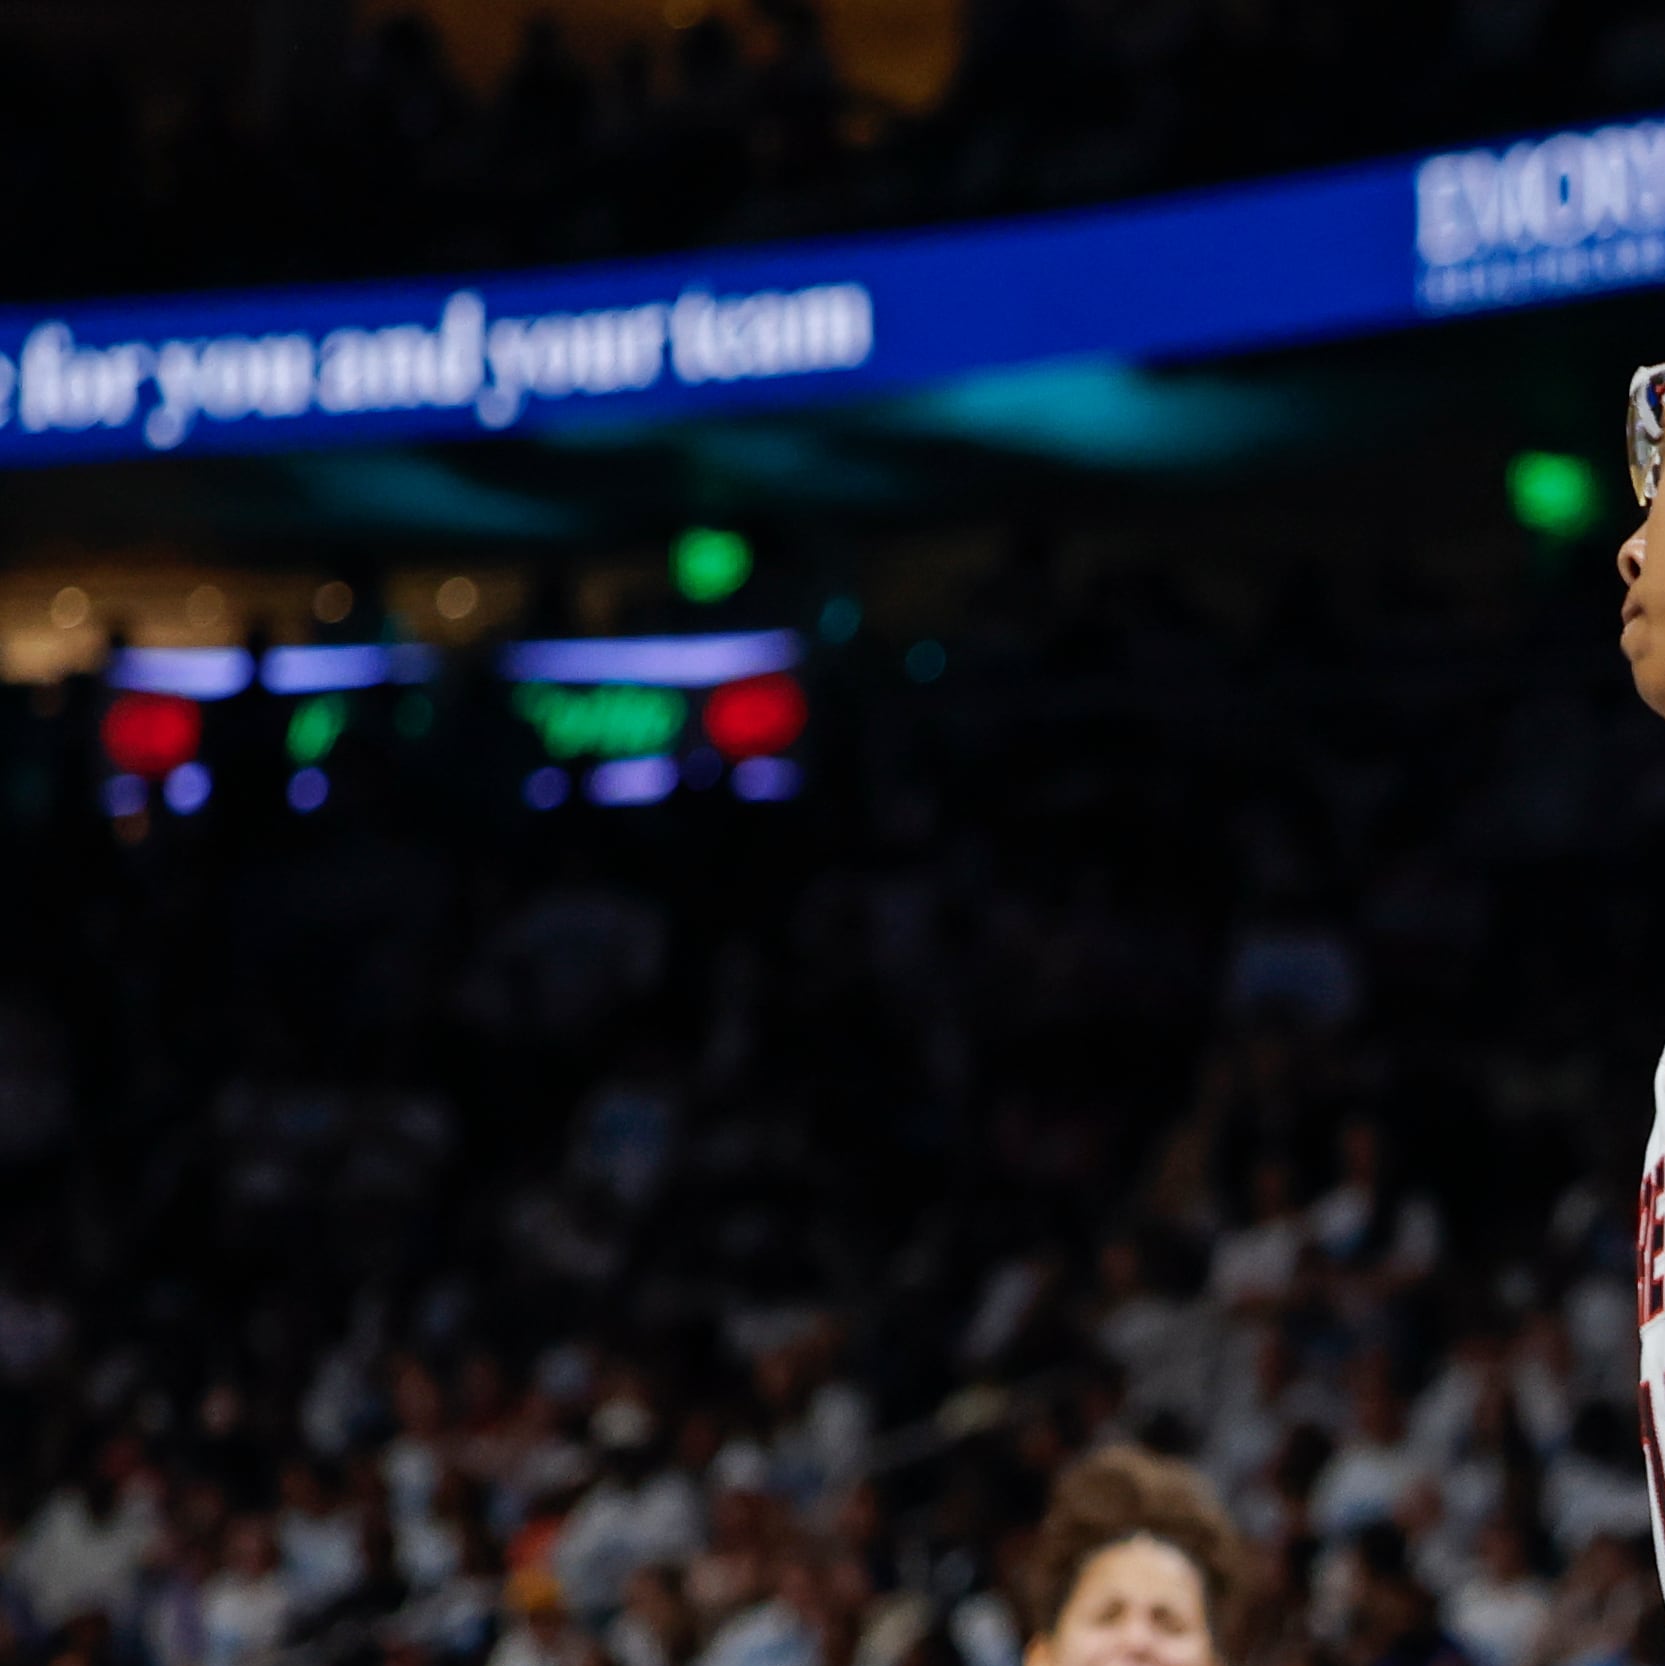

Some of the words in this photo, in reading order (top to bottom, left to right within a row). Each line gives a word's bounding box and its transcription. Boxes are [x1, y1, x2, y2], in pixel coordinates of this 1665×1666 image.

[19, 321, 153, 433] for
[144, 335, 314, 449] you
[317, 289, 487, 412] and
[476, 302, 668, 430] your
[668, 281, 873, 384] team
